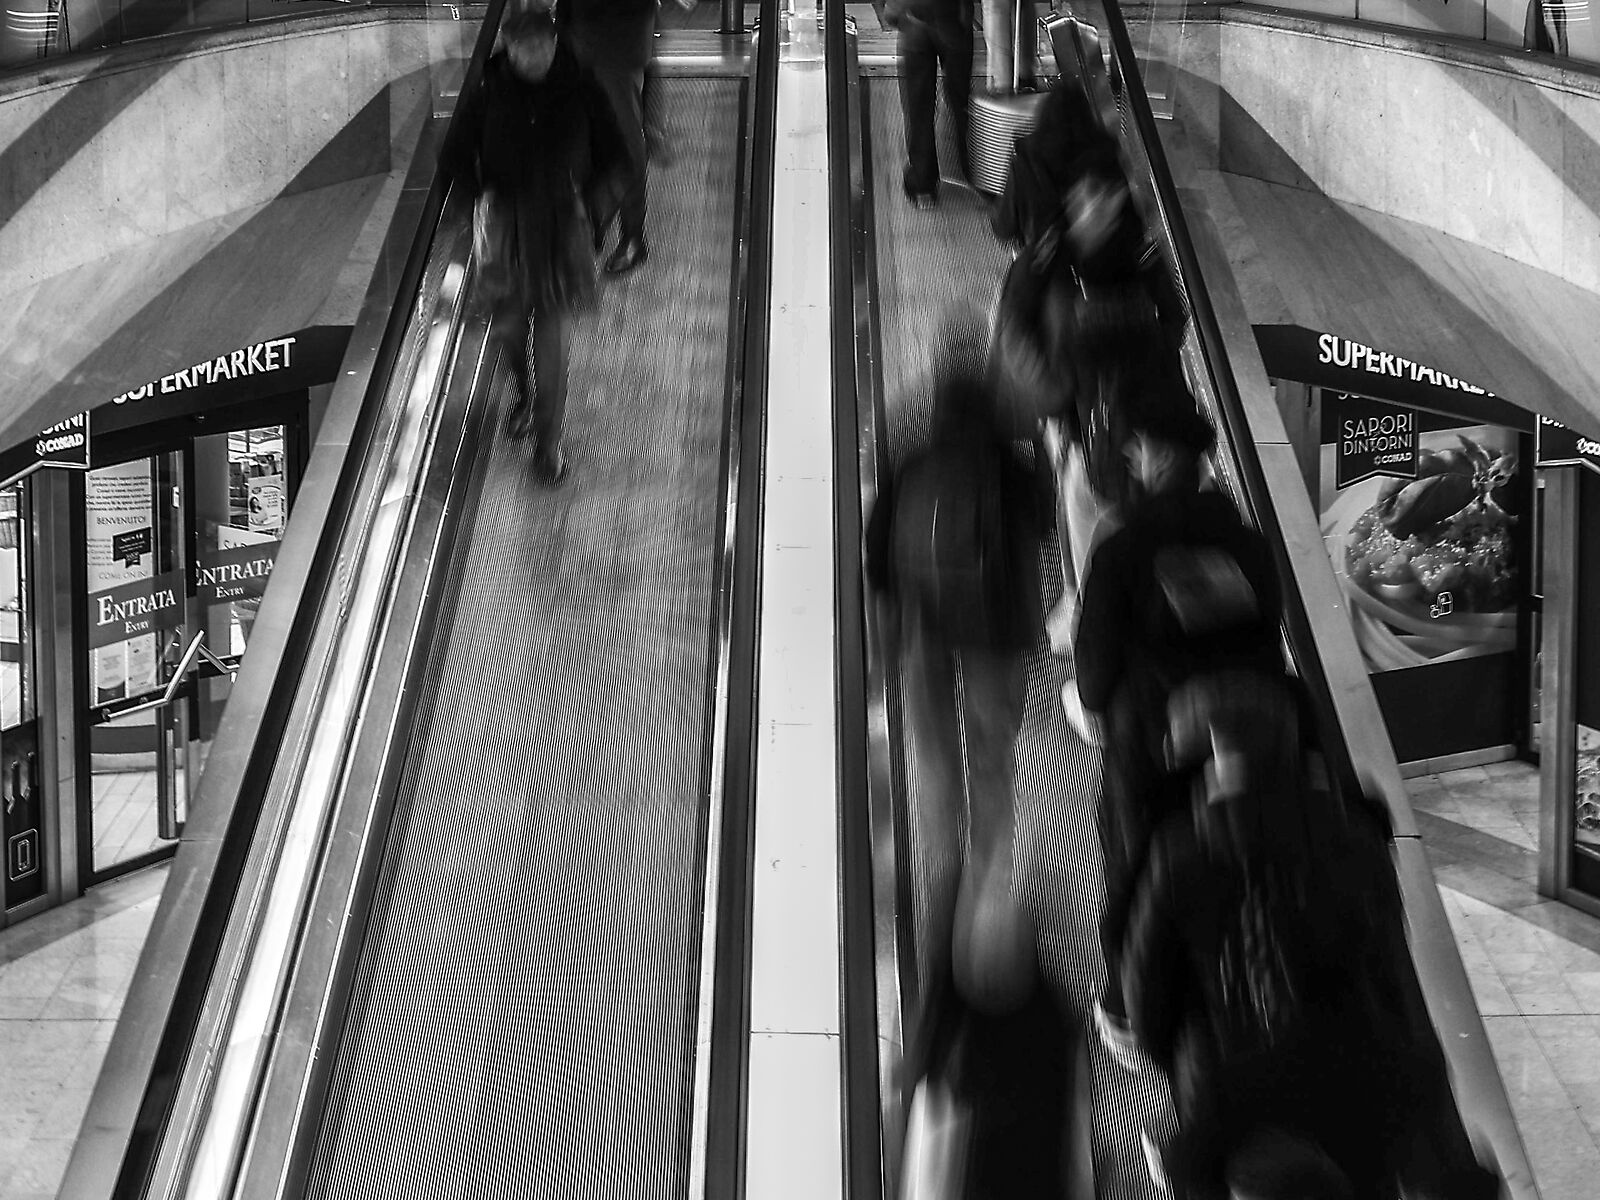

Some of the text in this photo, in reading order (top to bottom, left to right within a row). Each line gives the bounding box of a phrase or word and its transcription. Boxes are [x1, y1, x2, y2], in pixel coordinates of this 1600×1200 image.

[1343, 413, 1413, 439] SAPORI
[1343, 433, 1413, 456] DINTORNI
[96, 589, 177, 627] ENTRATA
